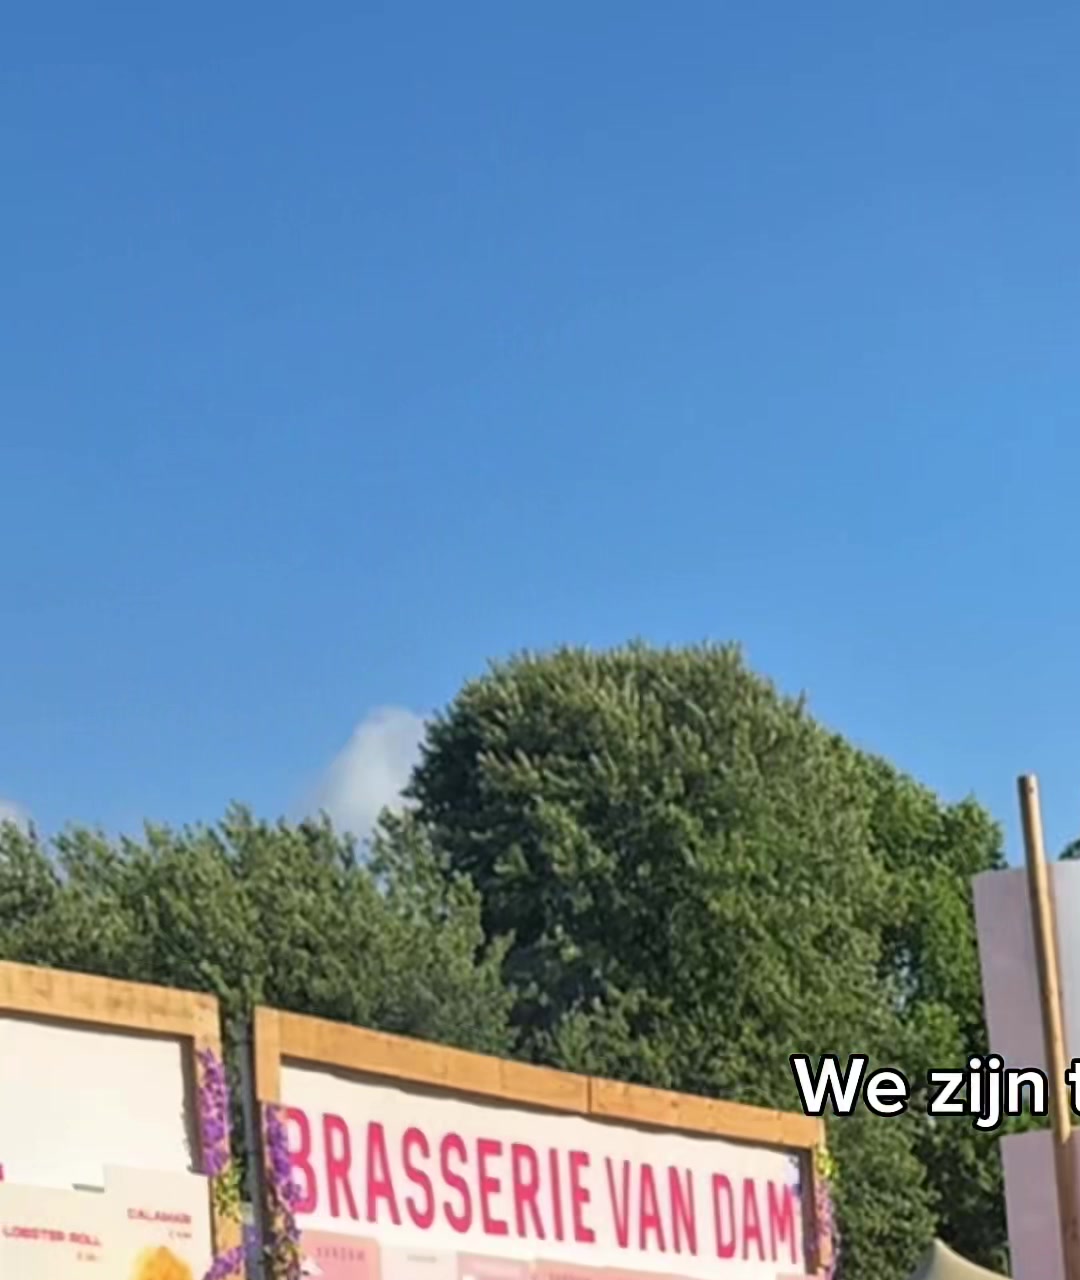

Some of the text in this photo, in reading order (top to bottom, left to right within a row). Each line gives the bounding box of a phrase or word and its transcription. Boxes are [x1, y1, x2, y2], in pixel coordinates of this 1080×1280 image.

[283, 1106, 798, 1265] BRASSERIE VAN DAM
